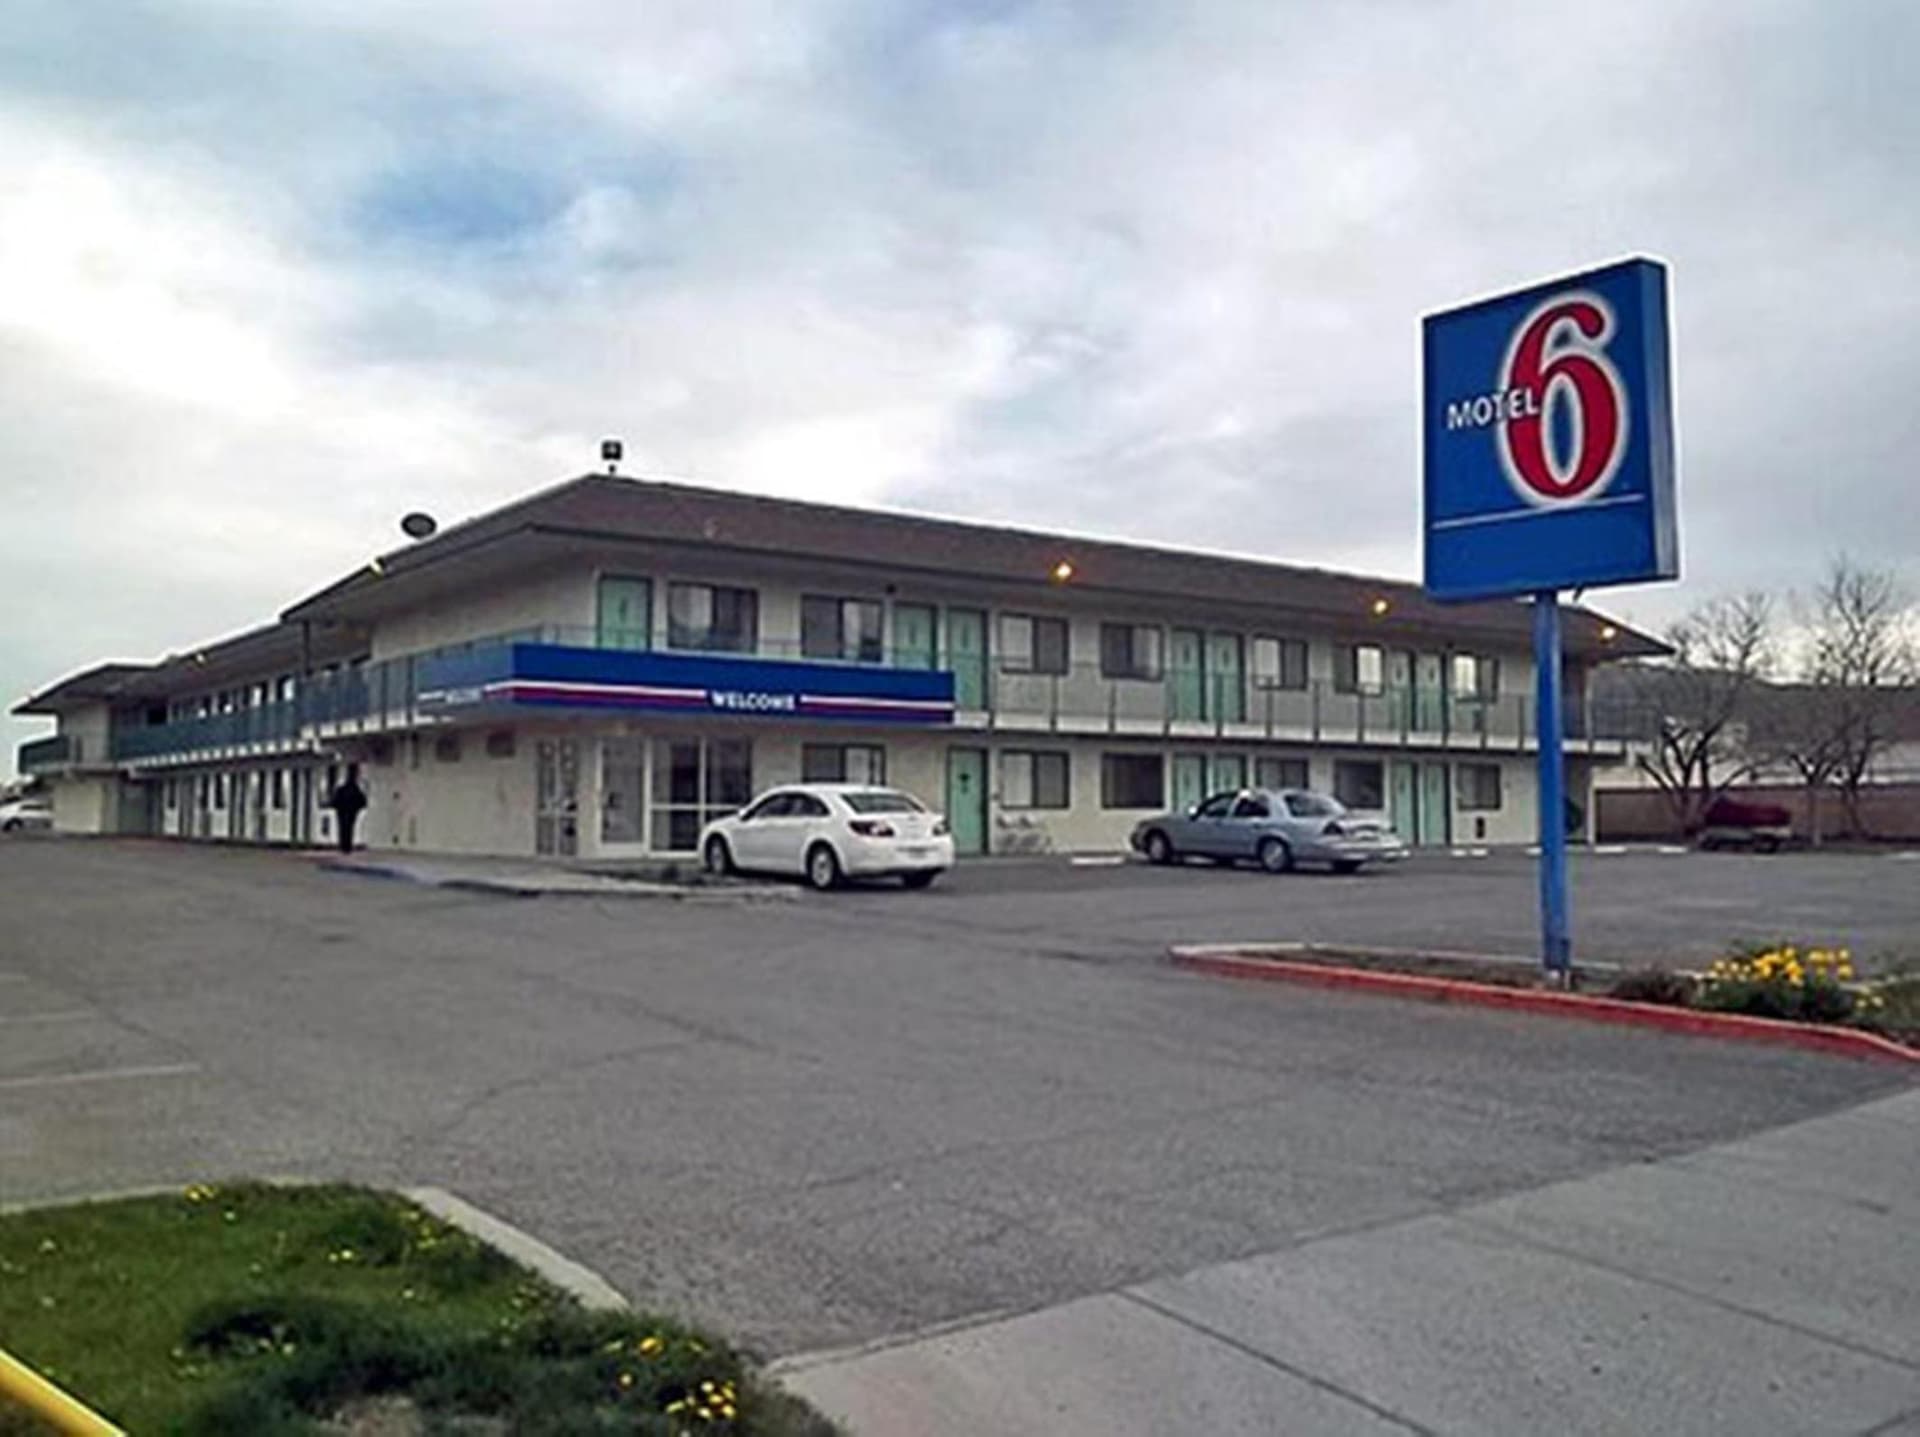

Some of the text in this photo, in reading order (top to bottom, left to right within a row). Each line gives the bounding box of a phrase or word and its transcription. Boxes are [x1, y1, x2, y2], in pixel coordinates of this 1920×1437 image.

[1448, 295, 1624, 503] MOTEL 6
[711, 690, 795, 711] WELCOME
